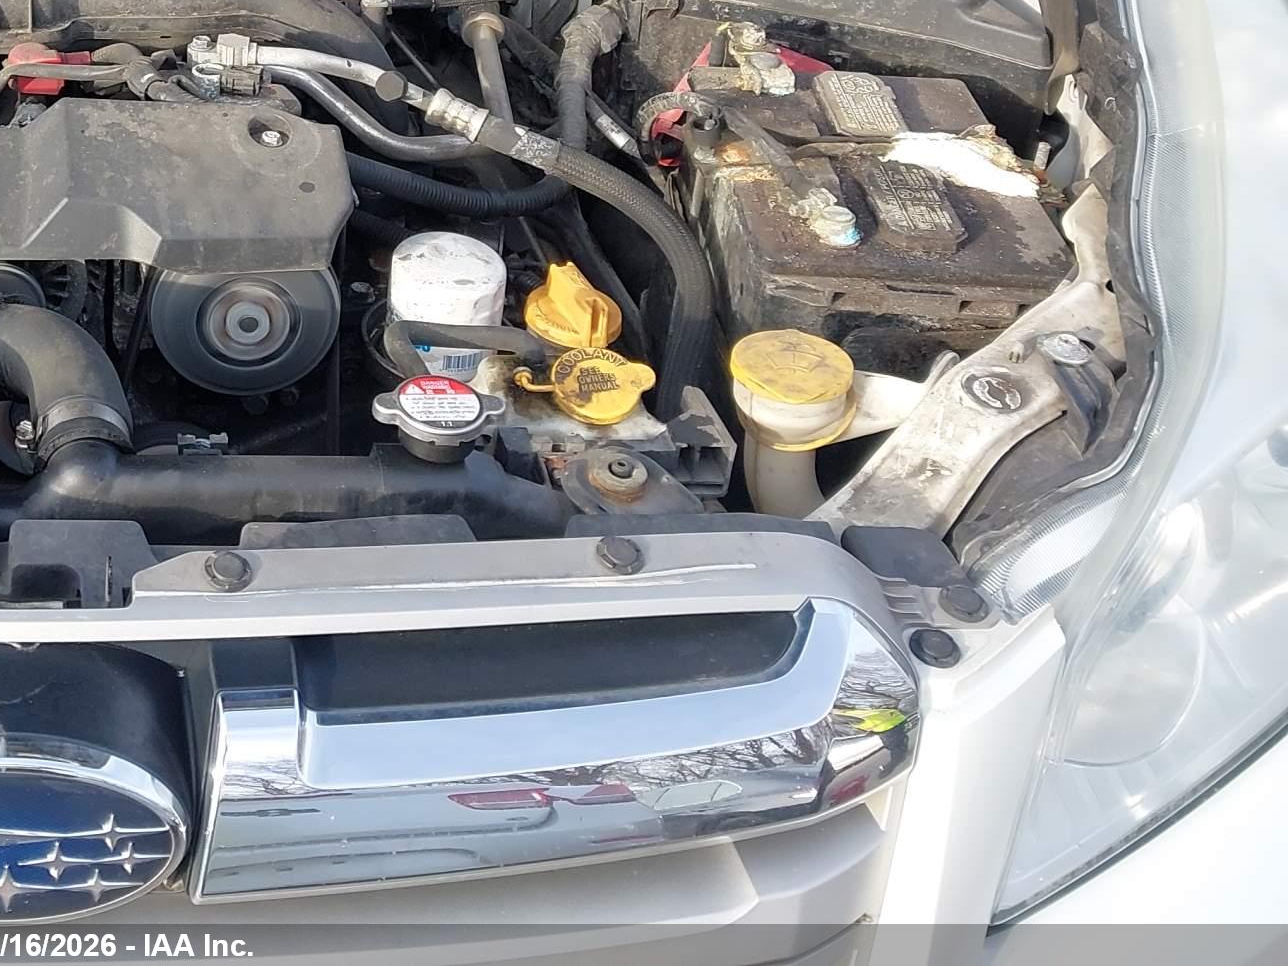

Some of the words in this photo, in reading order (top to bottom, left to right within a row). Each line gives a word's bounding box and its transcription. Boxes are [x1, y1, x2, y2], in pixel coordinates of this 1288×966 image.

[557, 348, 629, 374] COOLANT
[579, 366, 601, 375] SEE
[579, 381, 619, 392] MANUAL
